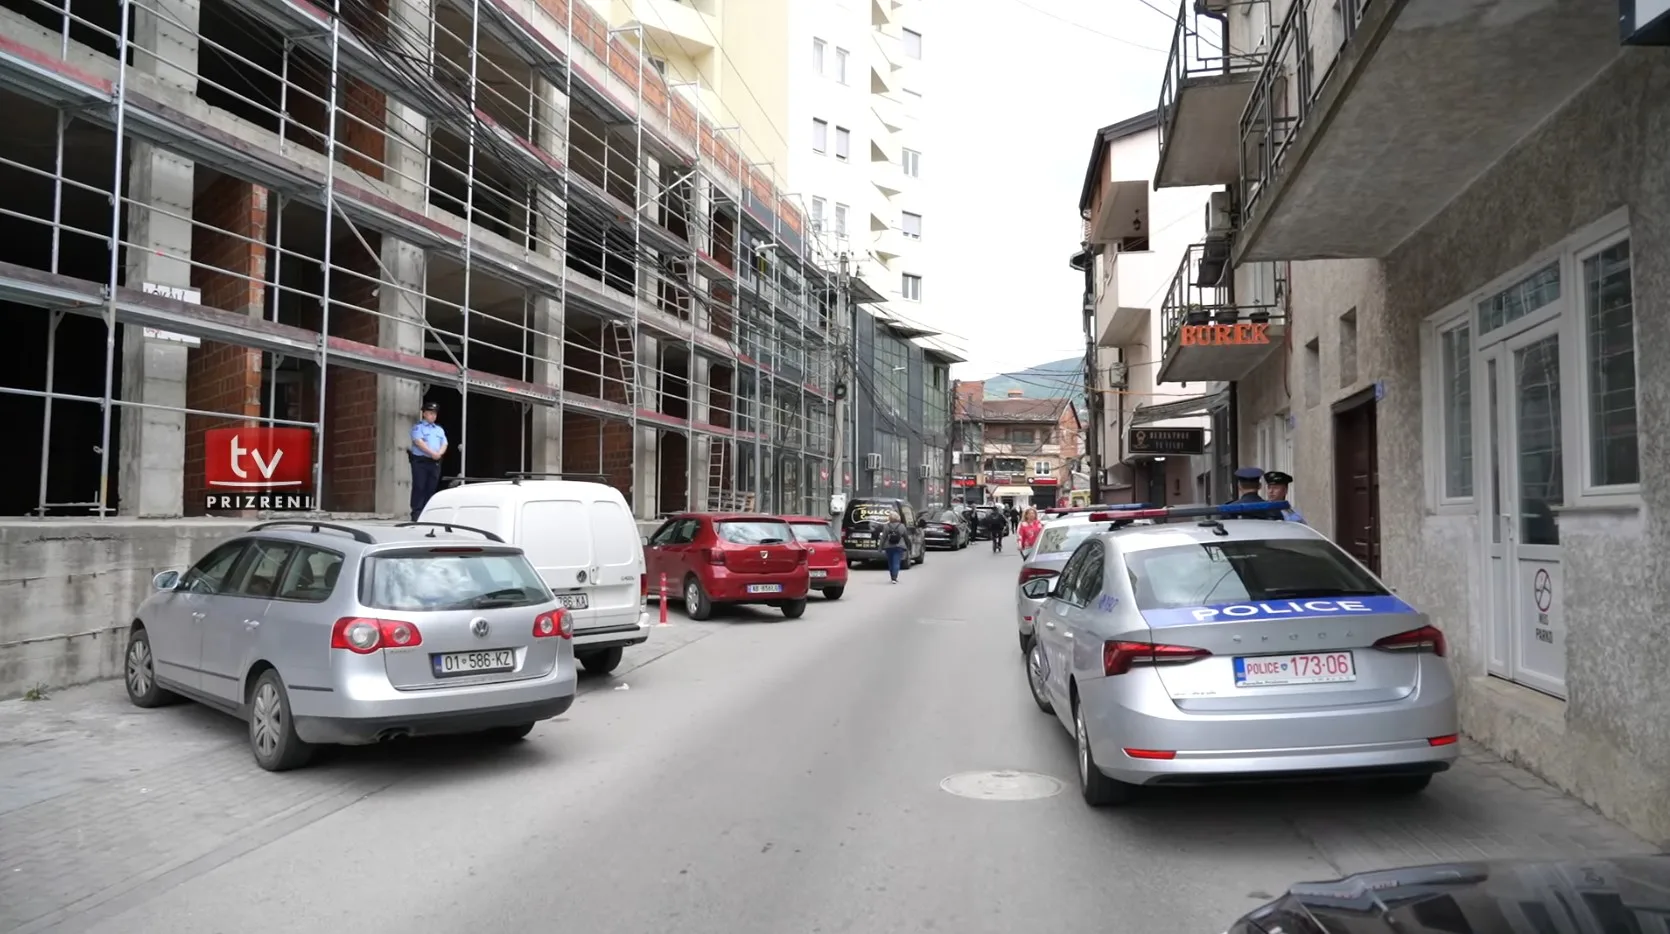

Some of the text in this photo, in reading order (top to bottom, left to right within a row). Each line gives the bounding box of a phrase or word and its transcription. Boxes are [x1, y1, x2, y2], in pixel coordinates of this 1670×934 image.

[1181, 324, 1270, 344] BUREK
[1192, 600, 1372, 621] POLICE
[1247, 662, 1280, 674] POLICE
